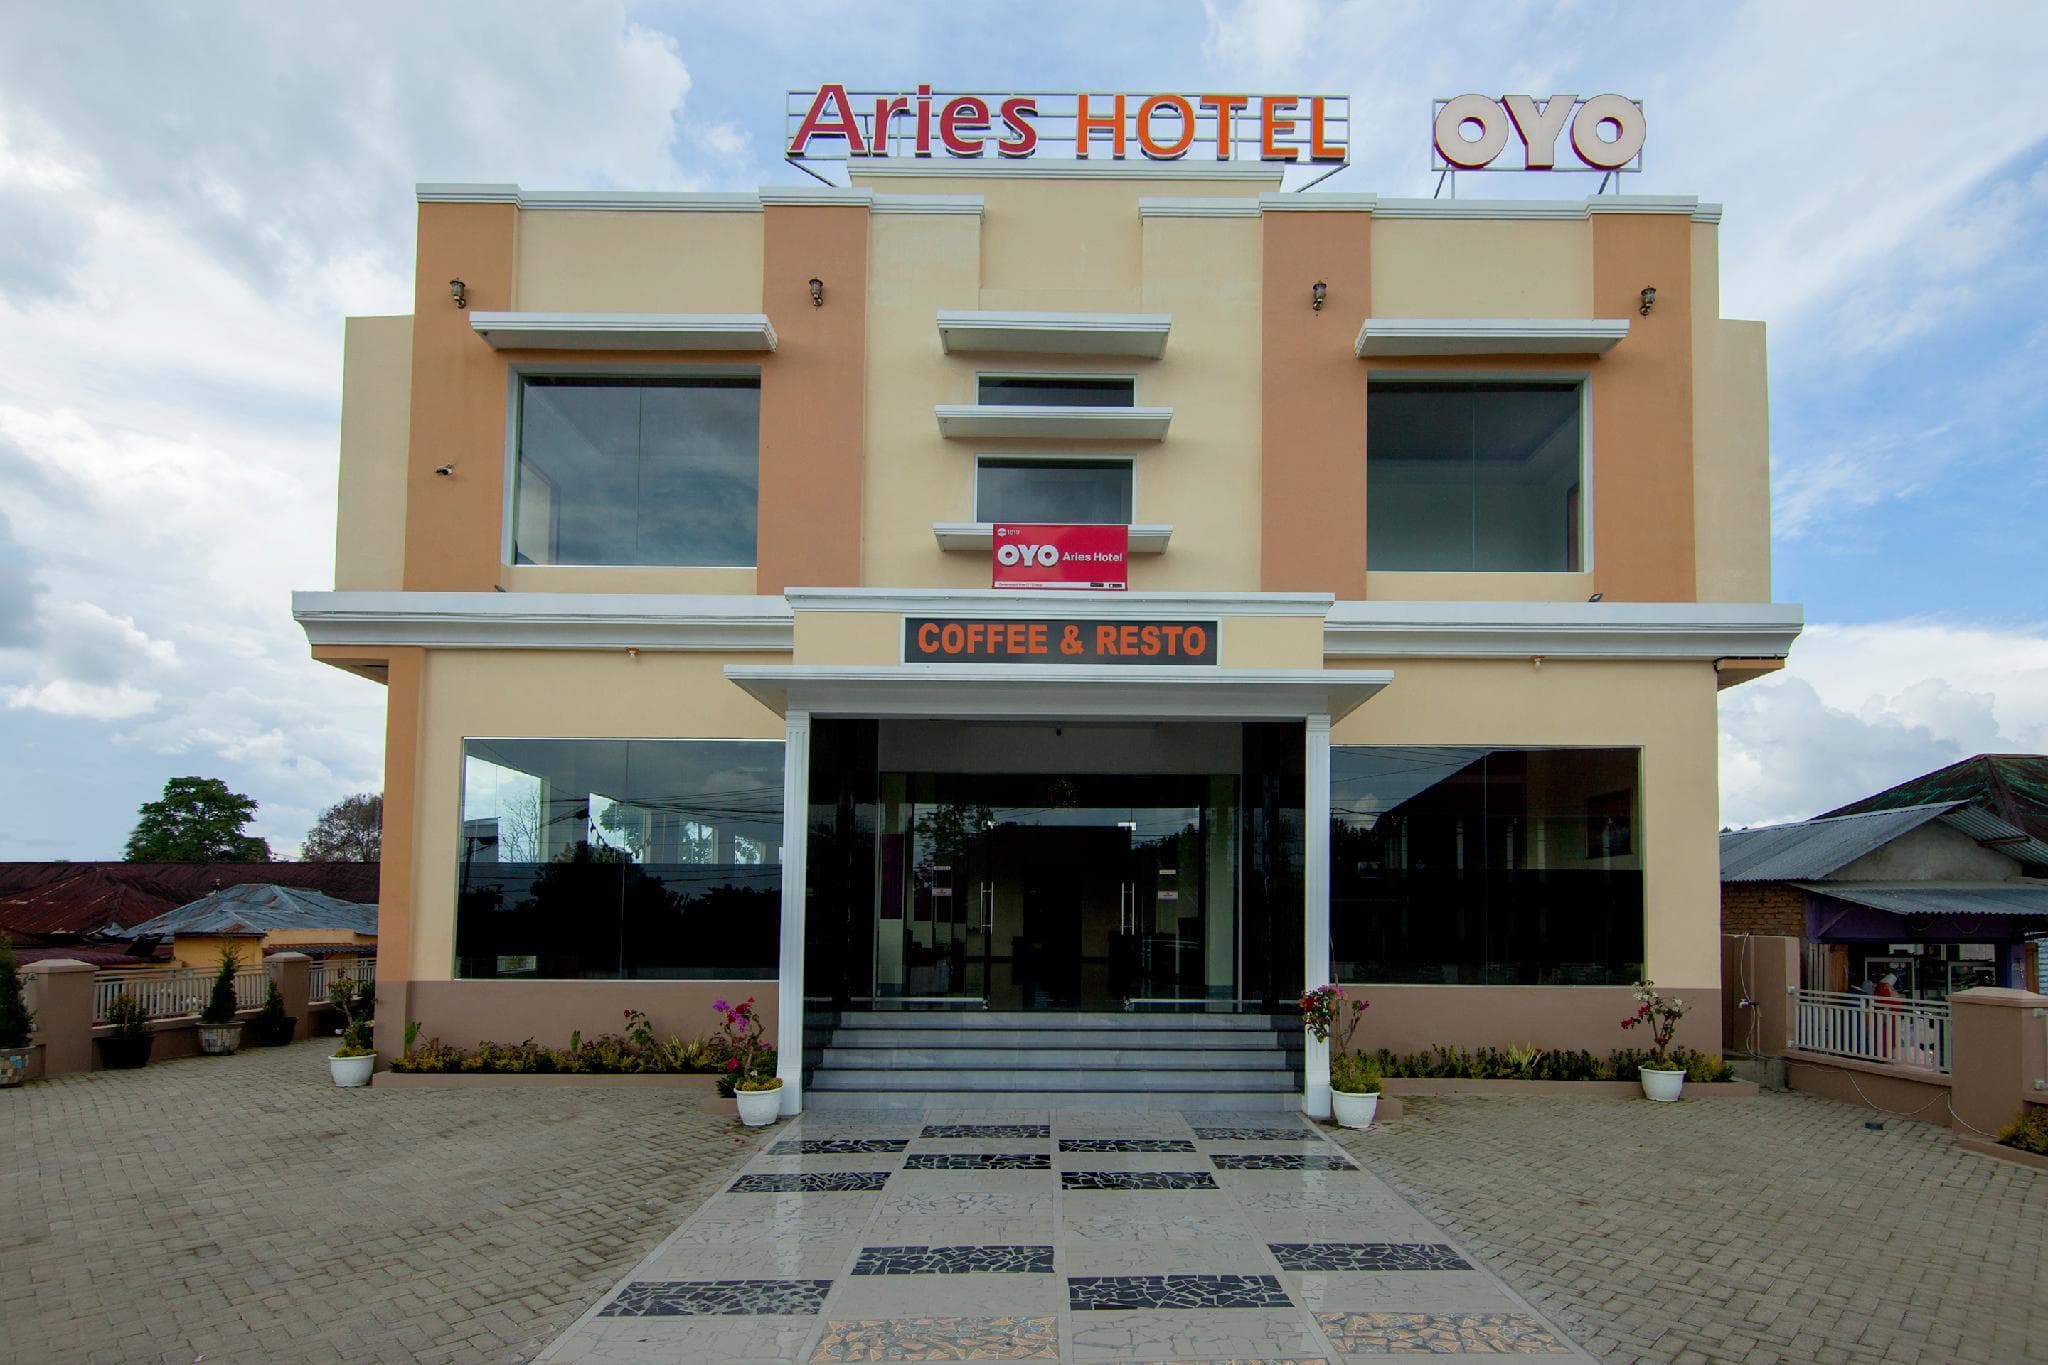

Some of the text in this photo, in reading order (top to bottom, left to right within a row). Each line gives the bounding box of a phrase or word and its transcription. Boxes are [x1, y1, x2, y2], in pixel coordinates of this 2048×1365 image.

[786, 83, 1346, 161] Aries HOTEL
[1433, 93, 1646, 169] OYO
[997, 544, 1122, 567] OYO Aries Hotel
[918, 622, 1206, 656] COFFEE & RESTO
